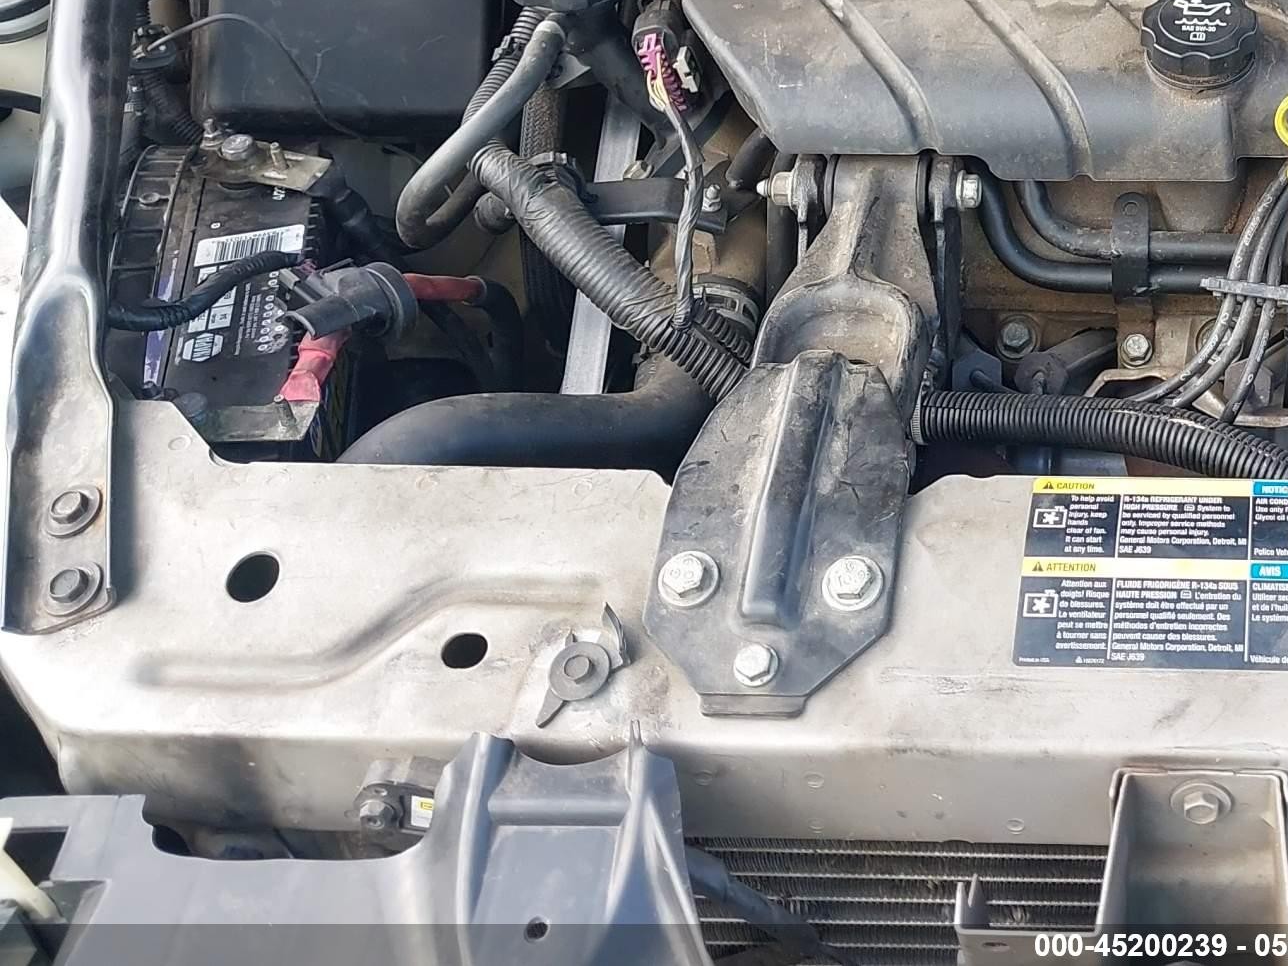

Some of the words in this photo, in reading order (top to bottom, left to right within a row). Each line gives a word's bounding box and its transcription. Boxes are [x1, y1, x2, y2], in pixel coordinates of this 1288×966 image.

[1138, 520, 1169, 528] Improper
[1047, 563, 1096, 572] ATTENTION
[1259, 567, 1281, 576] AVIS
[1061, 580, 1093, 588] Attention
[1117, 581, 1142, 589] FLUIDE
[1086, 591, 1110, 599] Risque
[1140, 591, 1177, 599] PRESSION
[1114, 612, 1149, 620] personnel
[1113, 633, 1138, 641] peuvent
[1112, 642, 1138, 650] General
[1111, 653, 1125, 661] SAE
